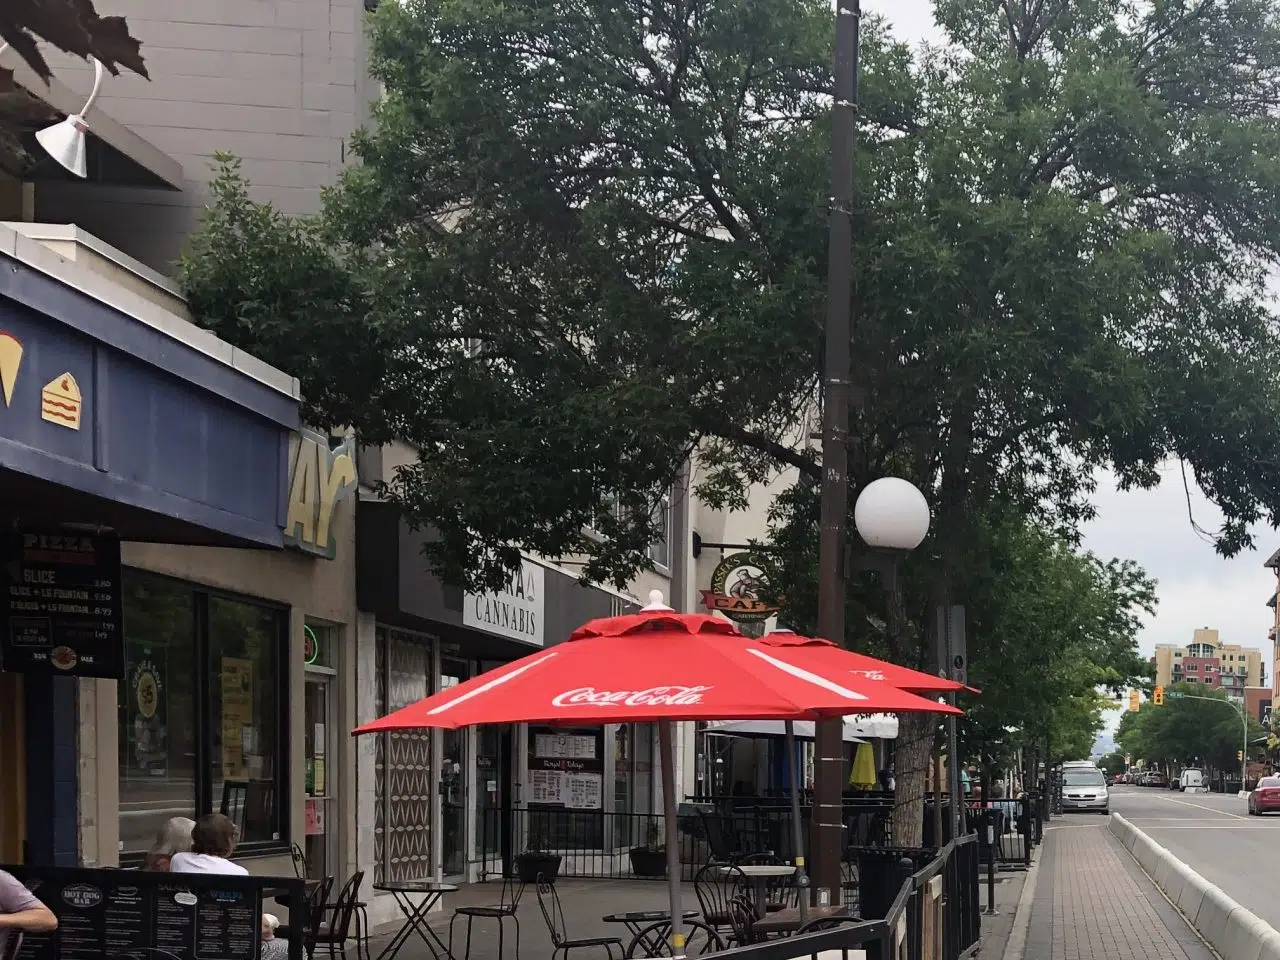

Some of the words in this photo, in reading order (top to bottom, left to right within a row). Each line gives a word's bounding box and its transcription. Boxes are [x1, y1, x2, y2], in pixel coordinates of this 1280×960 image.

[23, 534, 96, 552] PIZZA
[23, 569, 56, 584] SLICE
[714, 598, 769, 610] CAF
[475, 594, 535, 636] CANNABIS
[551, 685, 712, 707] Coca-Cola
[64, 890, 81, 899] HOT
[82, 891, 100, 900] DOG
